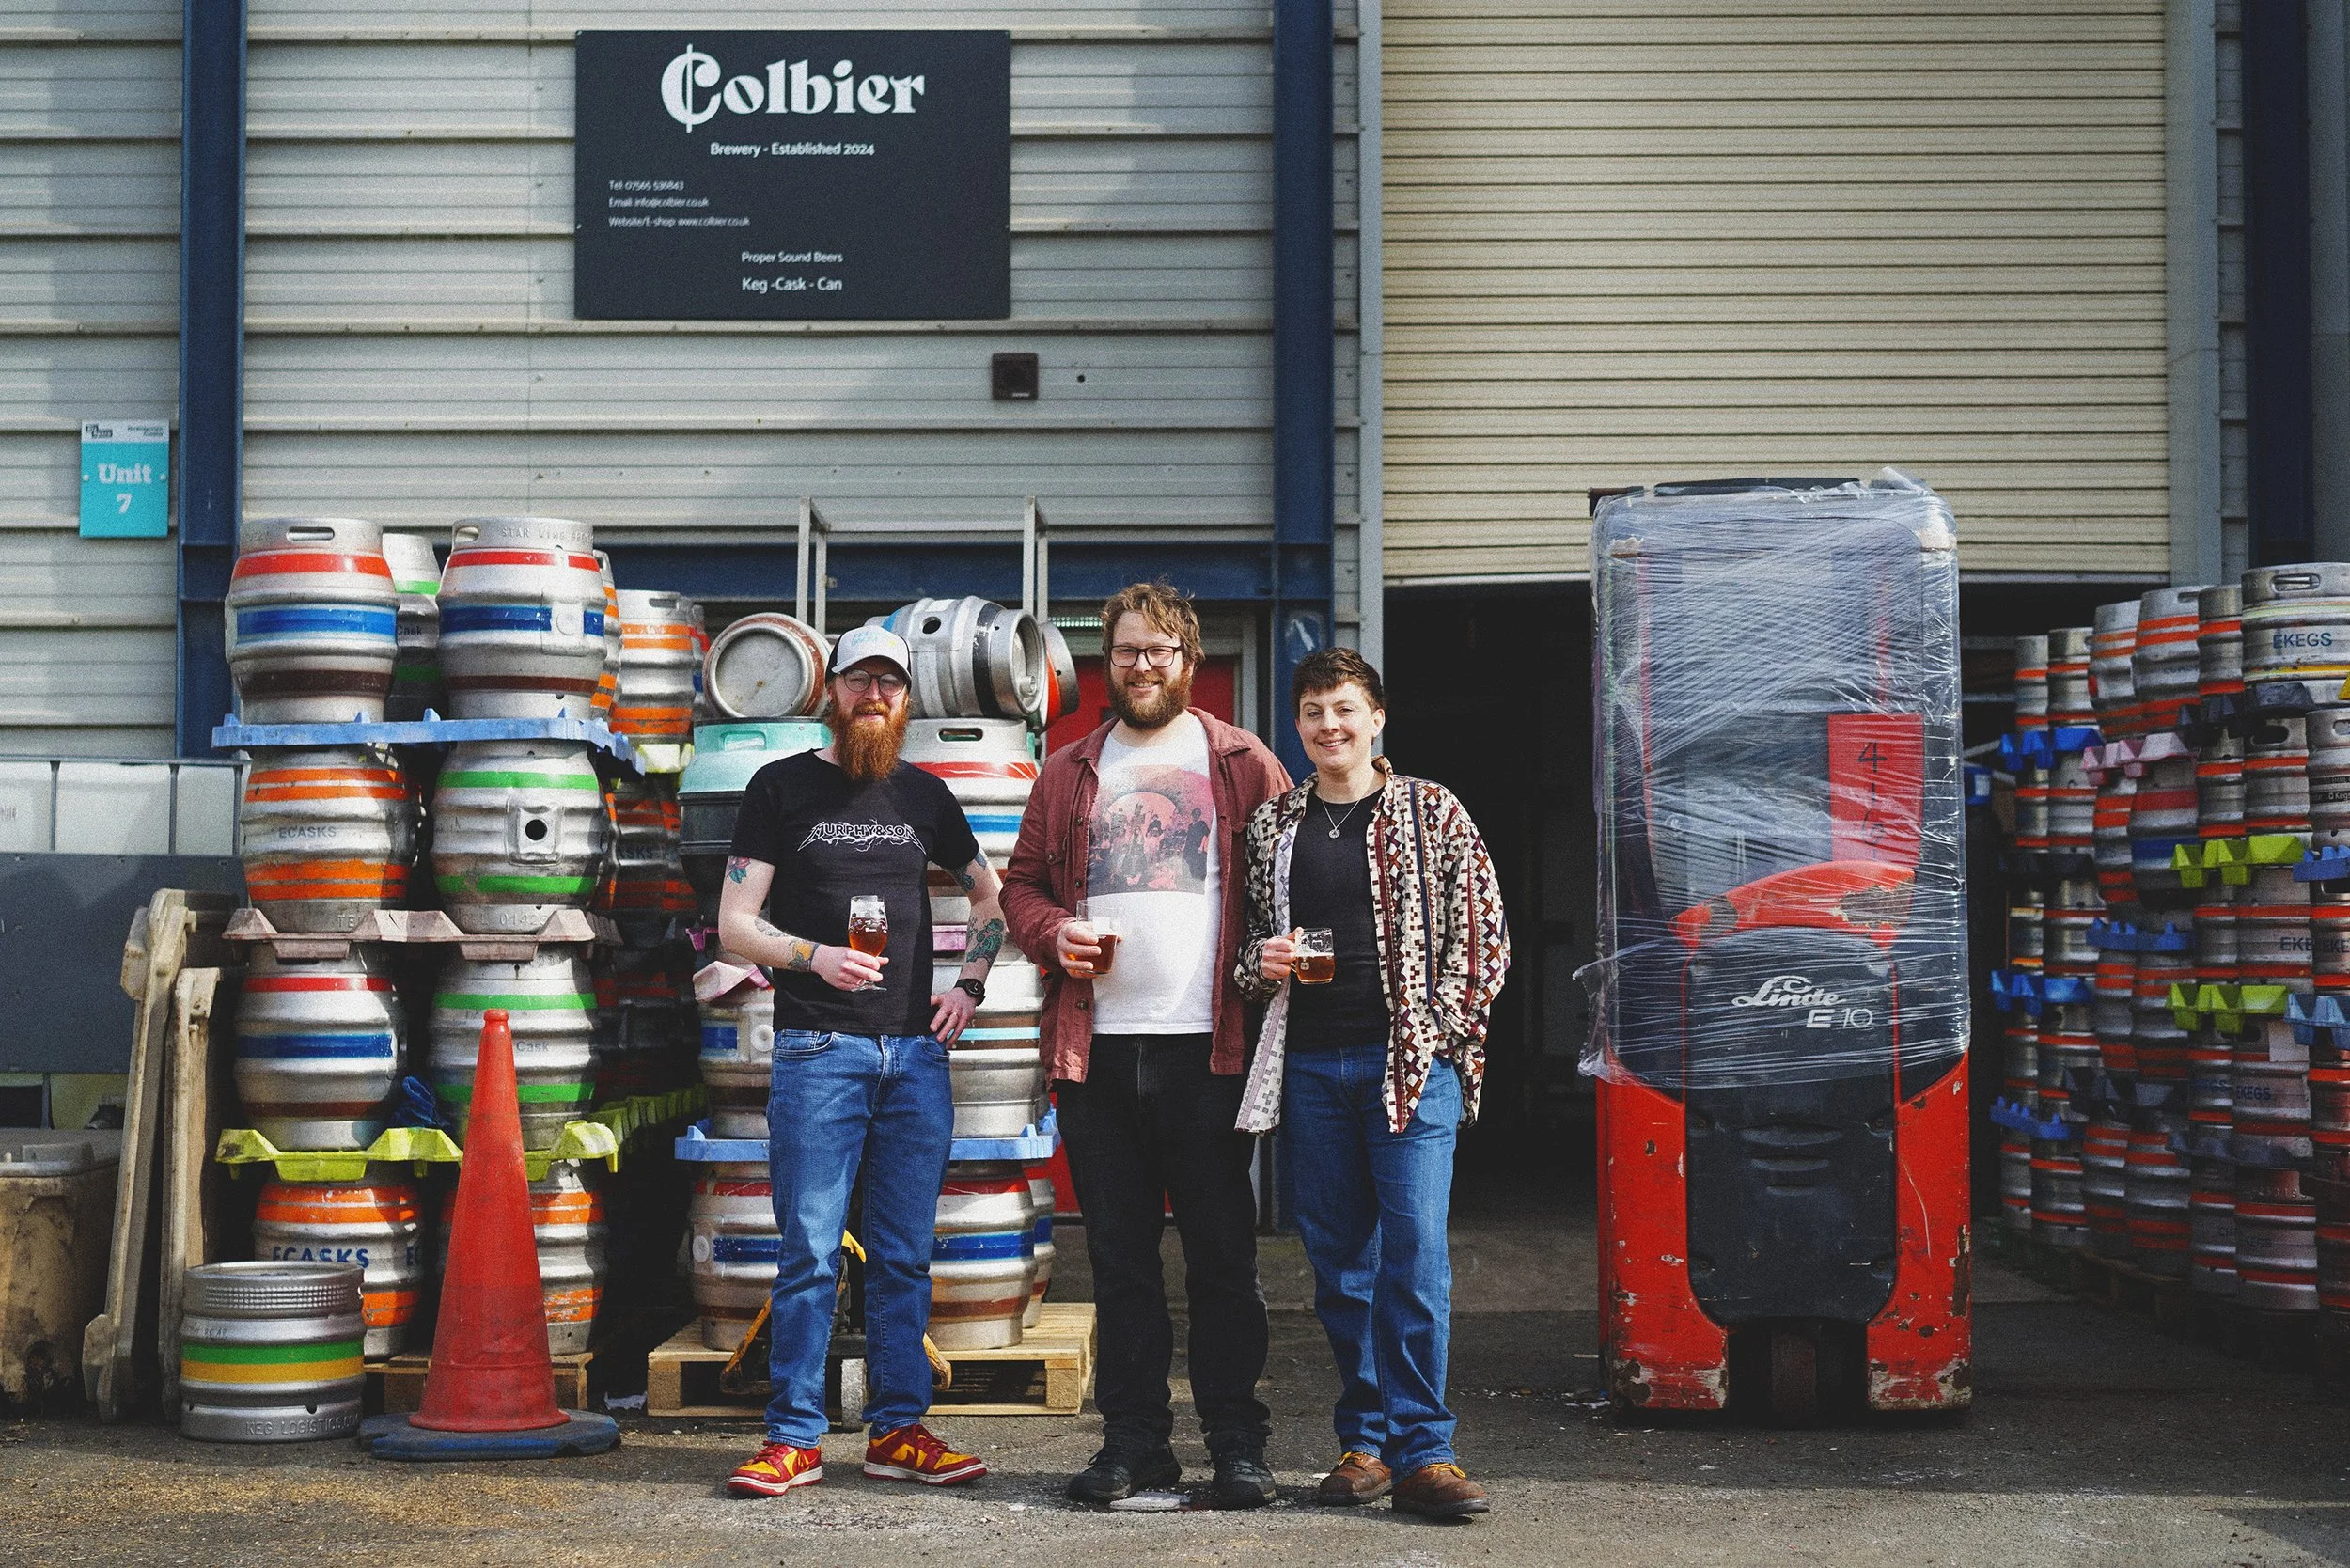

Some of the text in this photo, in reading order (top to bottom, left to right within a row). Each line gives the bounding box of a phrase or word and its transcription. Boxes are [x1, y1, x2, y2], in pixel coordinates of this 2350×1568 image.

[661, 43, 926, 133] Colbier
[710, 142, 761, 158] Brewery
[771, 142, 841, 155] Established
[843, 143, 875, 156] 2024
[741, 250, 844, 265] Proper Sound Beers
[742, 277, 769, 294] Keg
[817, 276, 843, 291] Can
[98, 463, 151, 484] Unit
[117, 494, 133, 515] 7
[2273, 632, 2333, 649] EKEGS
[1856, 741, 1888, 773] 4
[278, 825, 337, 839] ECASKS
[1731, 975, 1847, 1007] Linde
[1806, 1008, 1874, 1028] E 10
[245, 1420, 273, 1435] KEG
